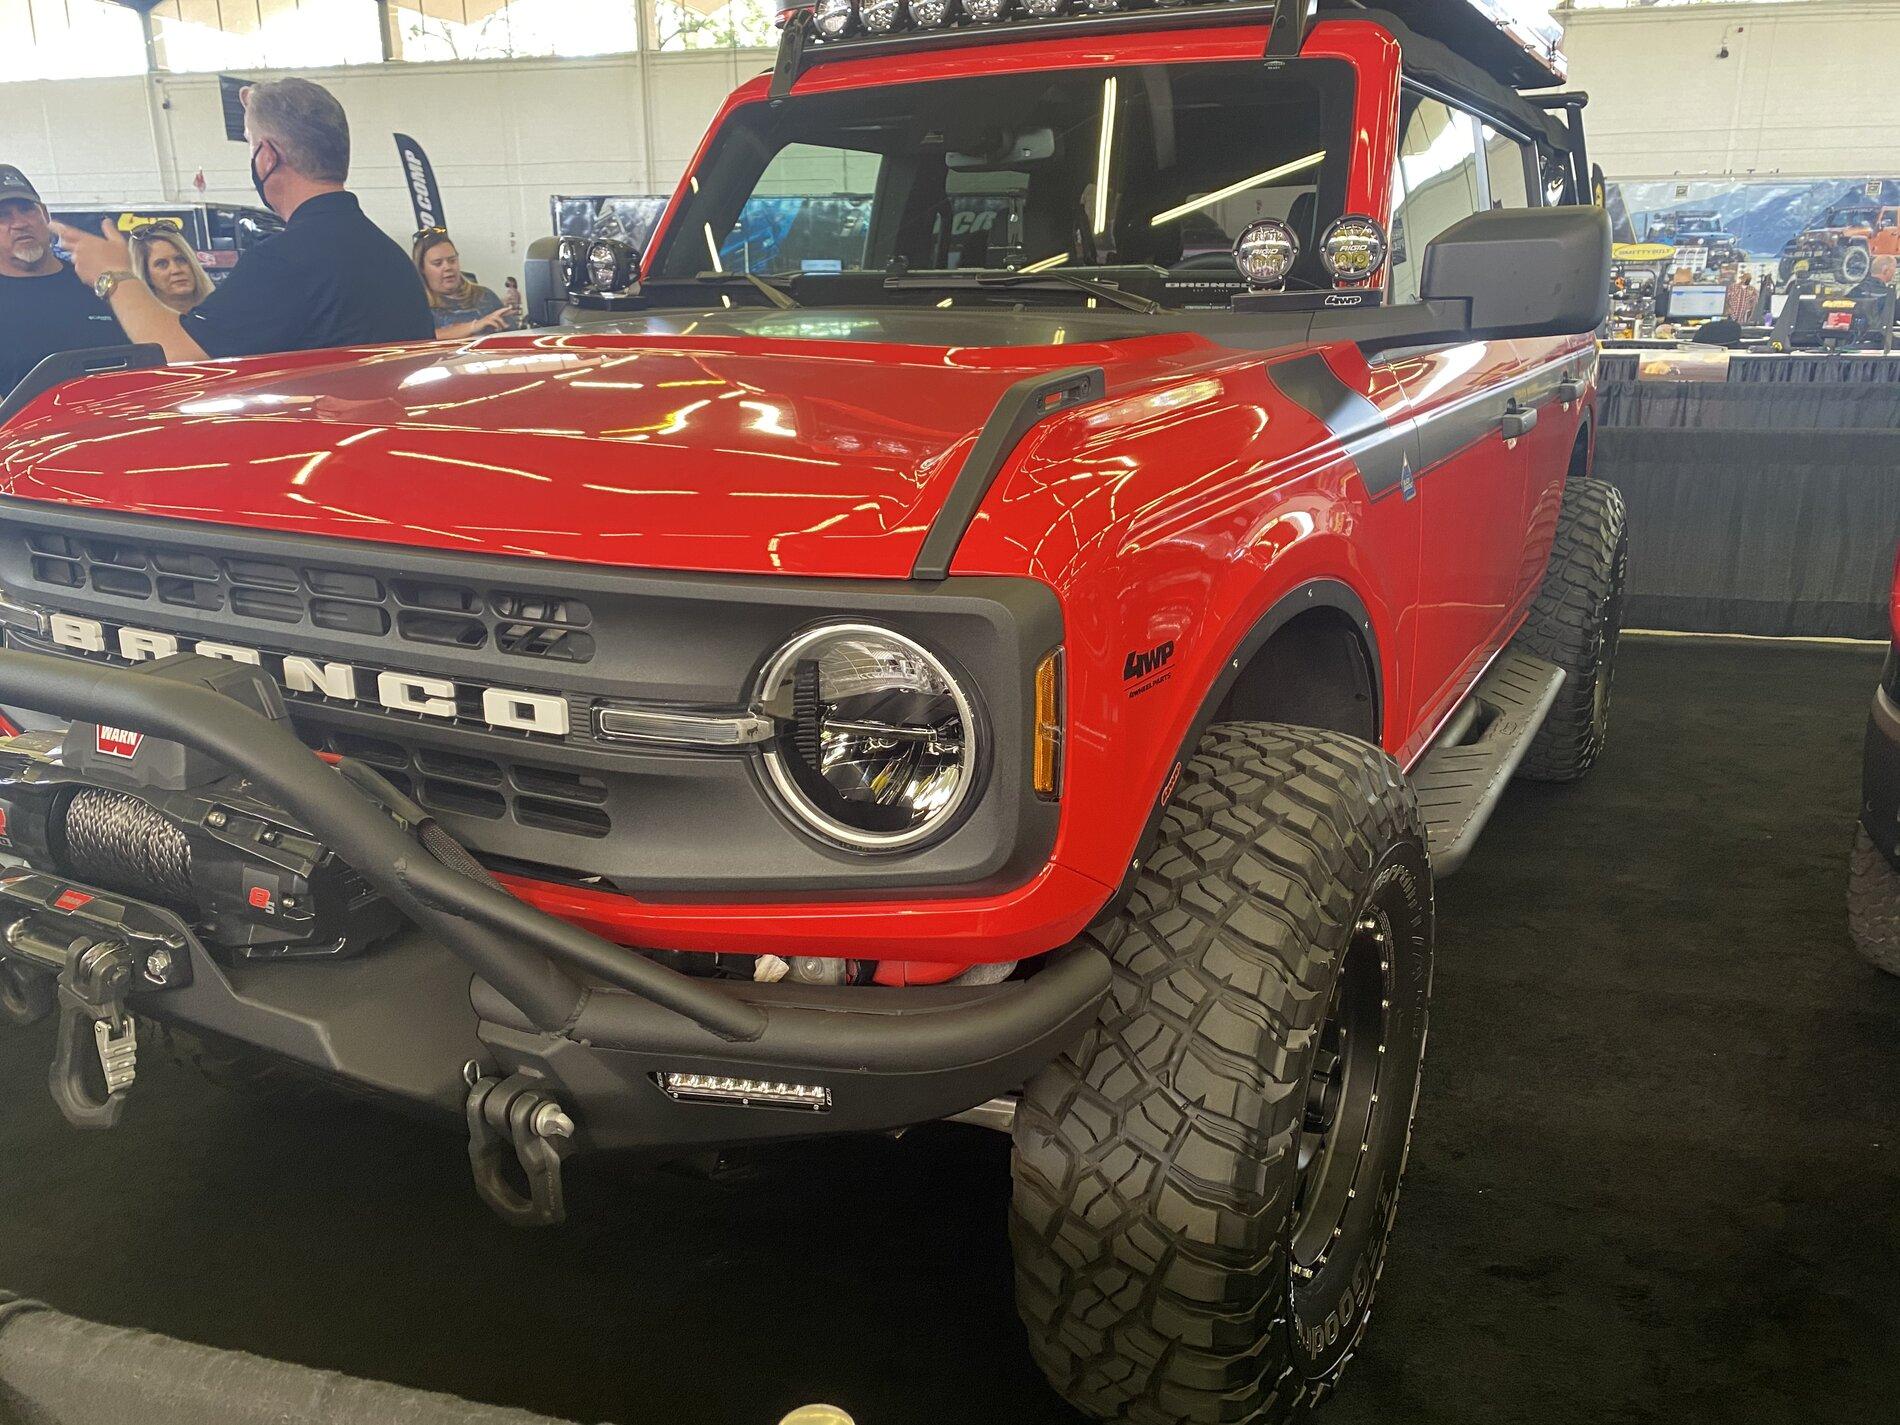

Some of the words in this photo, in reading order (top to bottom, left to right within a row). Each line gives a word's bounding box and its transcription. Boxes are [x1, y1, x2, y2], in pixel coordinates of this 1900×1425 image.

[404, 148, 433, 212] COMP
[1325, 295, 1361, 306] 4WP
[1123, 640, 1174, 681] 4WP
[101, 725, 138, 746] WARN
